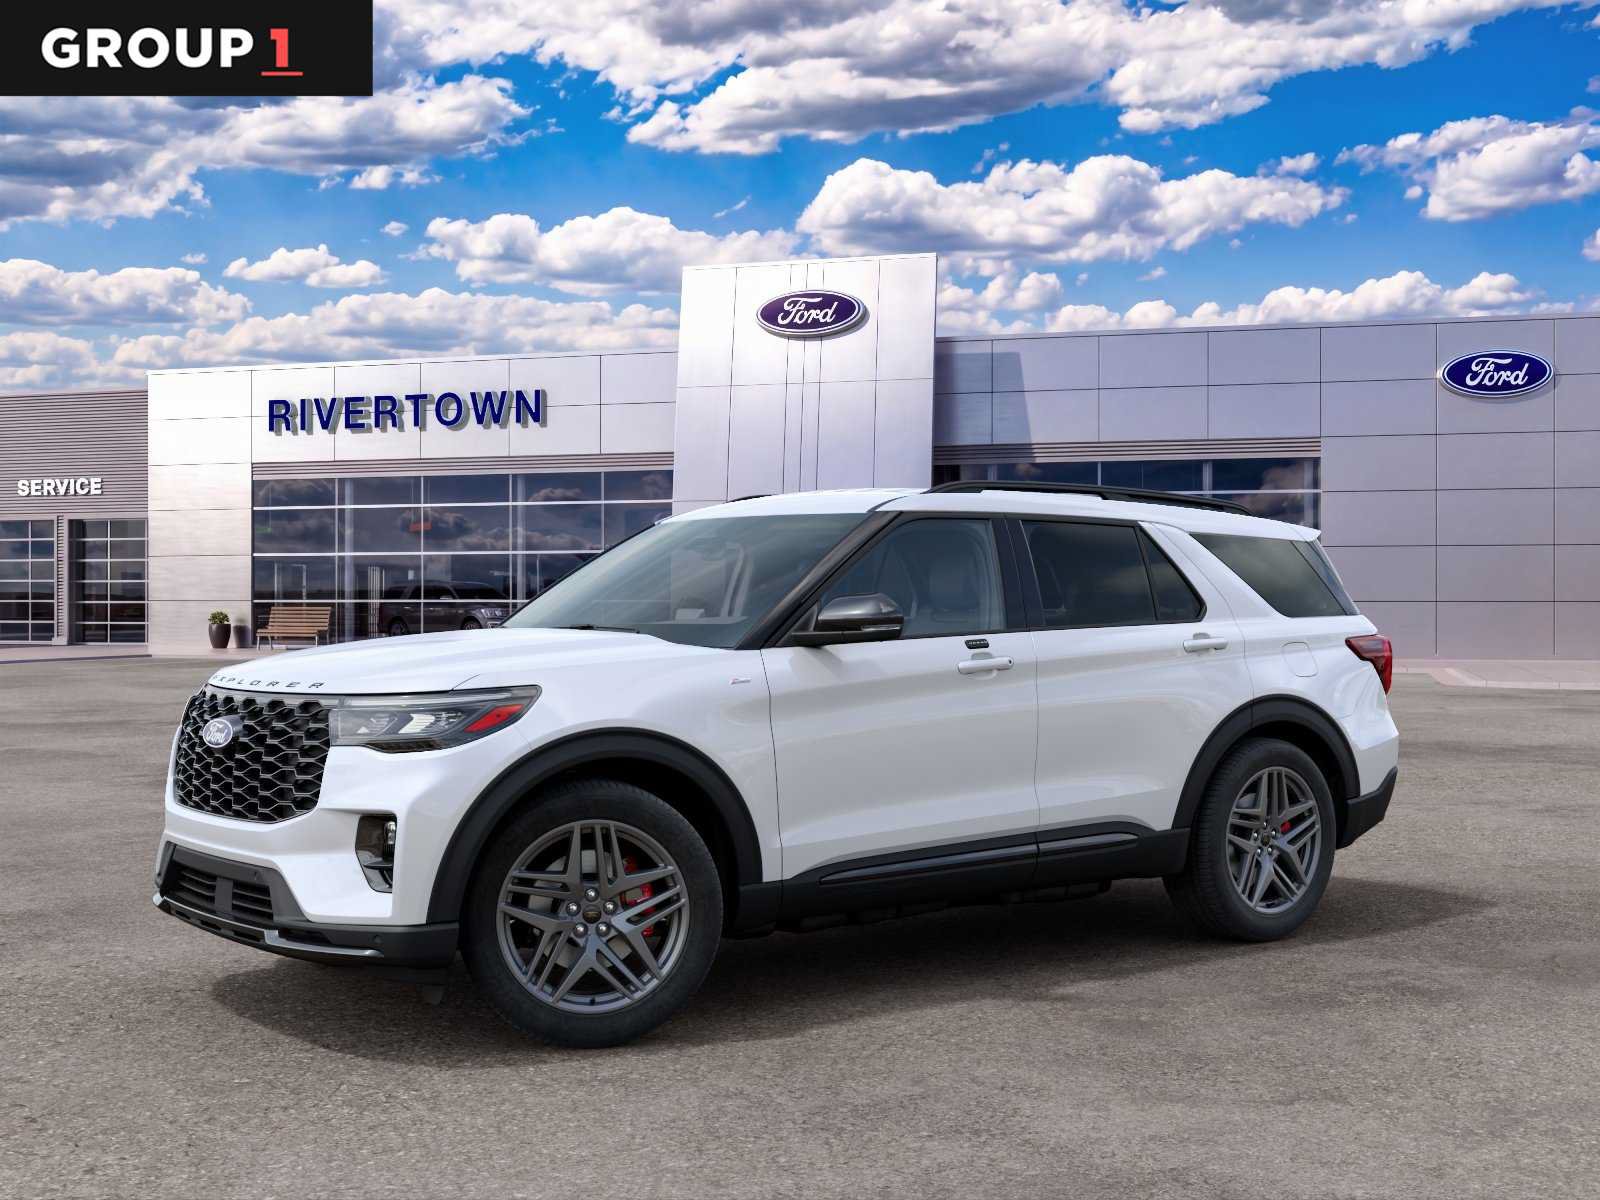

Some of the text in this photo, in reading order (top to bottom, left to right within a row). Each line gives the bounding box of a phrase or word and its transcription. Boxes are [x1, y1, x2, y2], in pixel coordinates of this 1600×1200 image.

[777, 297, 838, 325] Ford
[1465, 357, 1529, 386] Ford
[268, 389, 542, 433] RIVERTOWN
[17, 477, 102, 496] SERVICE
